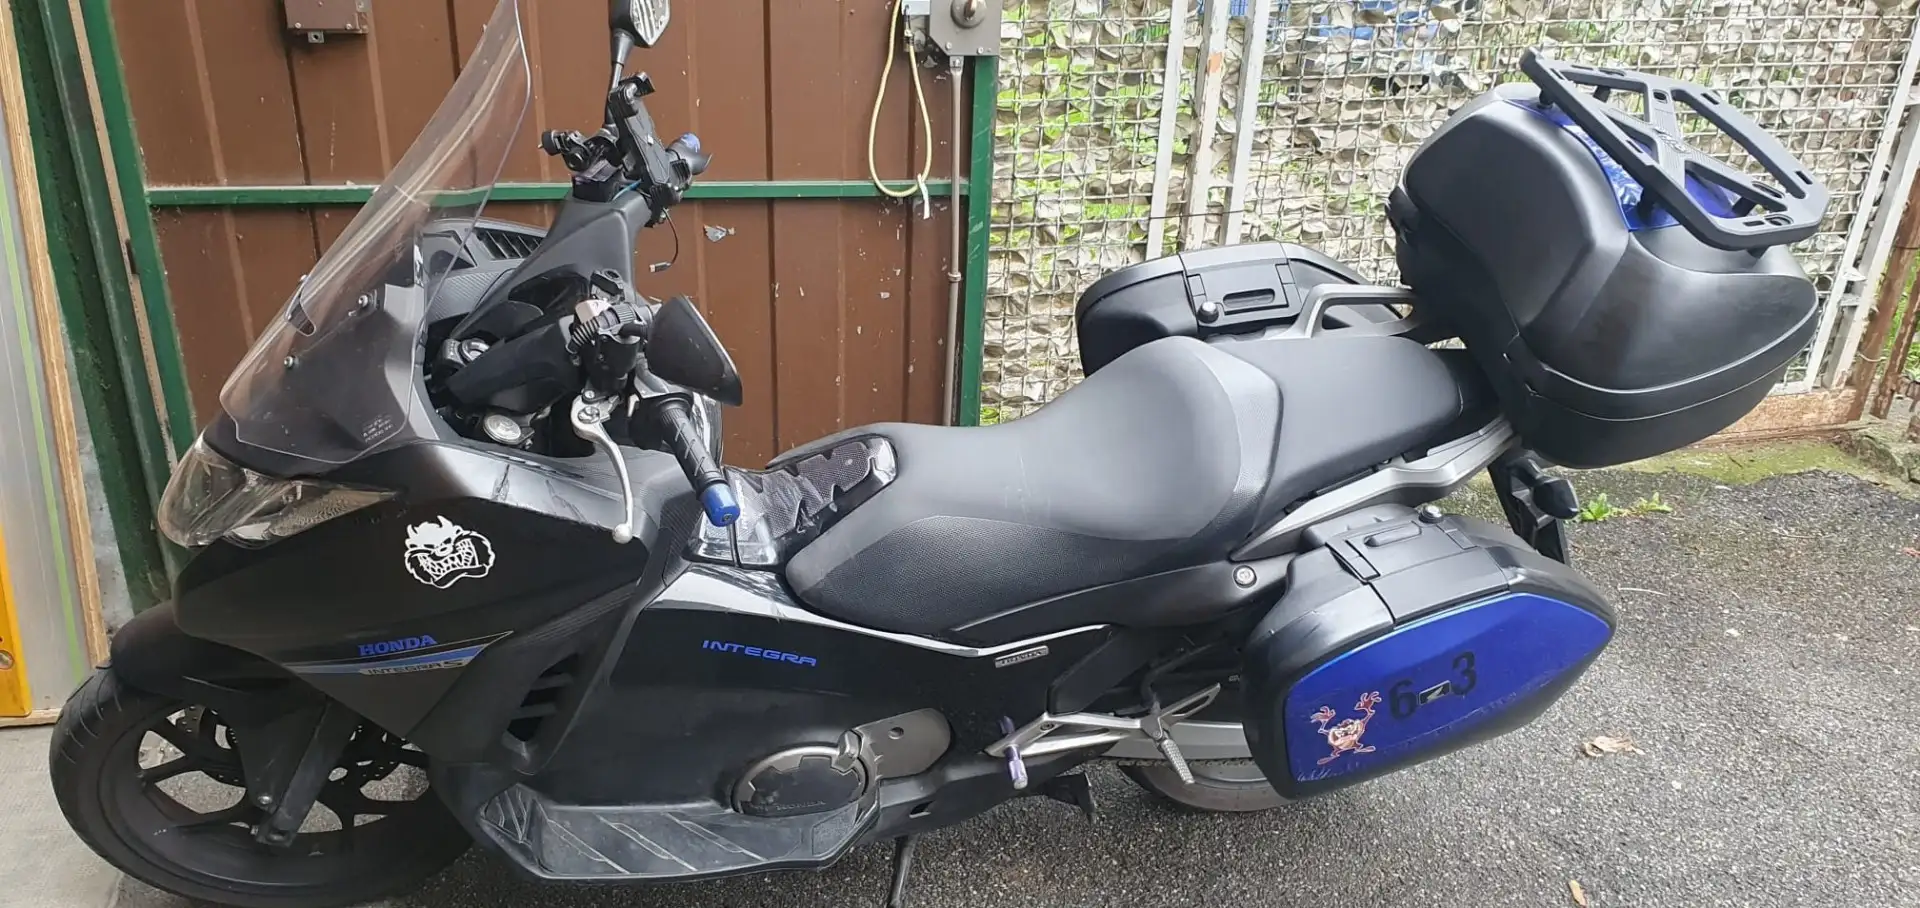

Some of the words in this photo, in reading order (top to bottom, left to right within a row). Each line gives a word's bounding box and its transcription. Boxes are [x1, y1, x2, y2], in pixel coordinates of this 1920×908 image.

[358, 635, 438, 656] HONDA
[702, 640, 817, 666] INTEGRA
[1389, 679, 1417, 720] 6
[1452, 651, 1476, 696] 3
